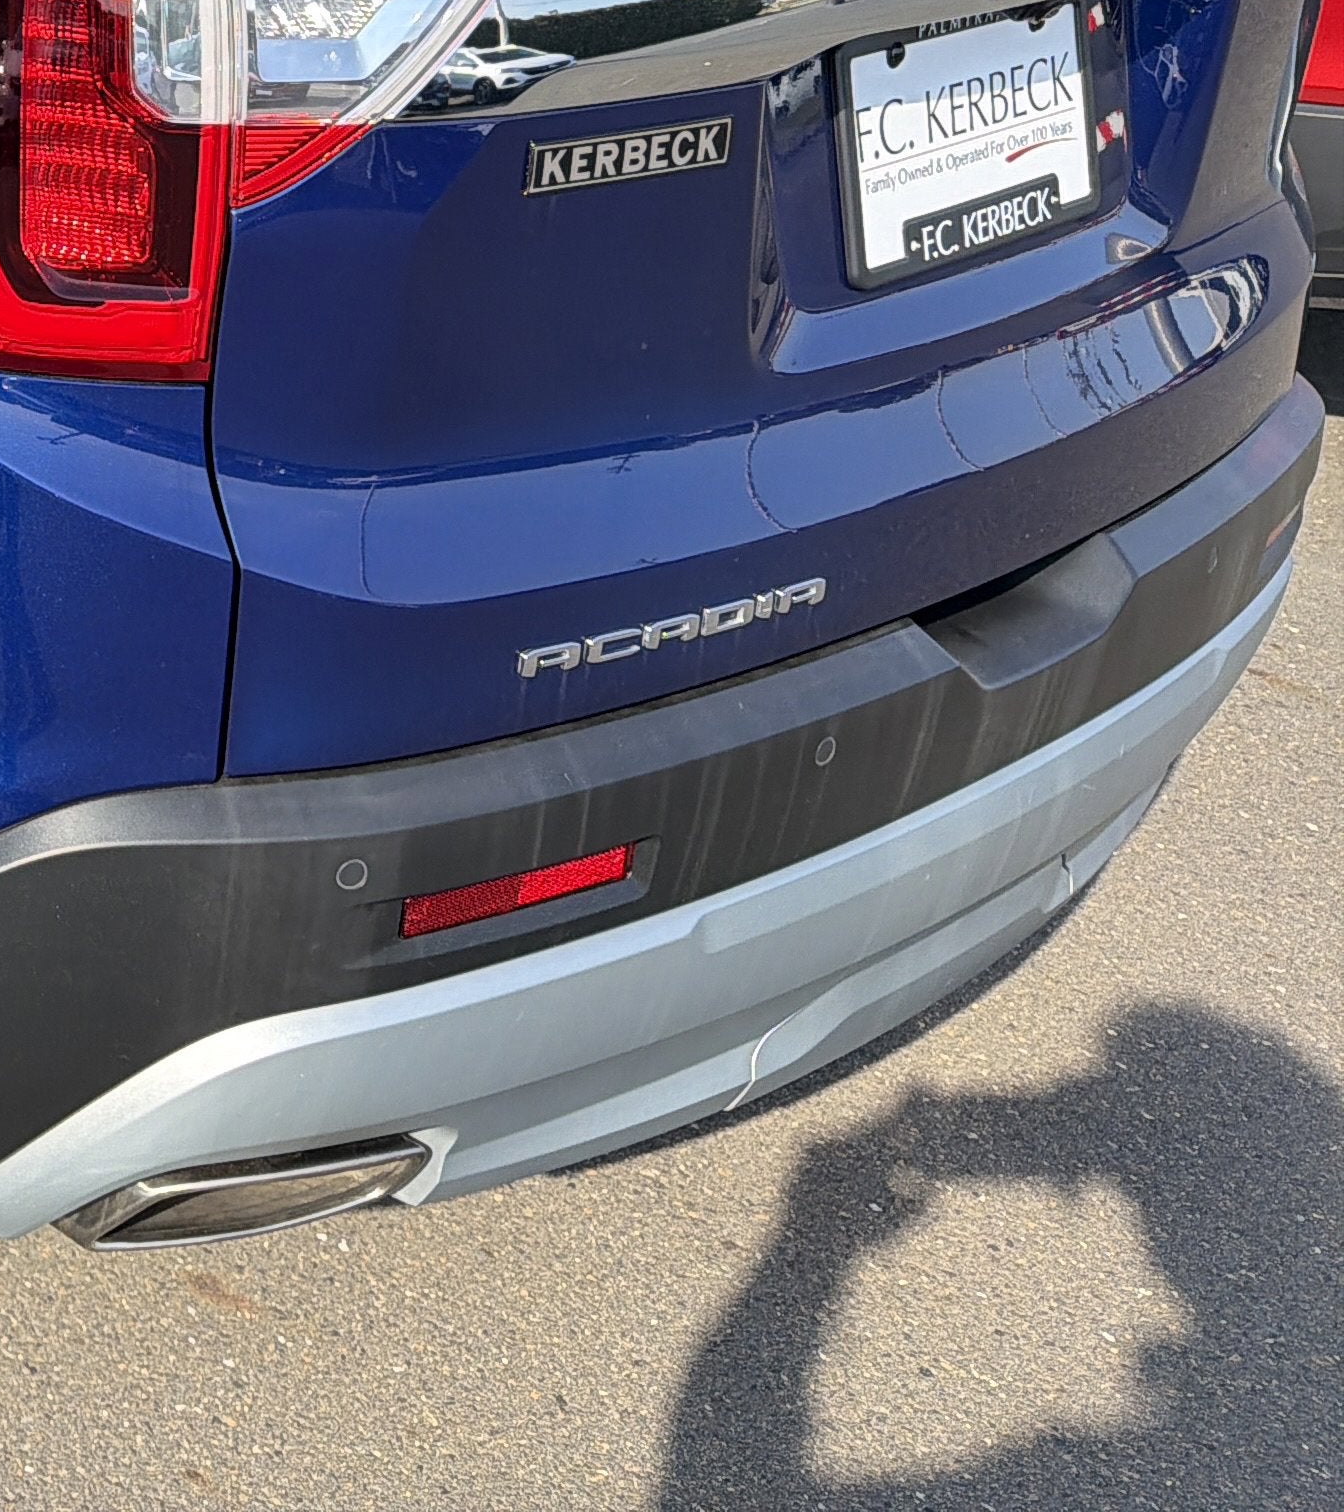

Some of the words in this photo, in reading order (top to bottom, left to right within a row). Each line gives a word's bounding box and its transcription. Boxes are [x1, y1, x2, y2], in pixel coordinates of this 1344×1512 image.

[856, 98, 914, 163] F.C.
[925, 51, 1073, 144] KERBECK
[540, 125, 721, 186] KERBECK
[865, 172, 896, 195] Family
[898, 159, 934, 185] Owned
[936, 157, 944, 174] &
[945, 140, 990, 172] Operated
[991, 139, 1006, 158] For
[1007, 134, 1030, 151] Over
[1032, 125, 1048, 143] 100
[1049, 121, 1074, 138] Years
[921, 219, 960, 262] F.C.
[962, 187, 1052, 249] KERBECK
[516, 577, 827, 678] ACADIA
